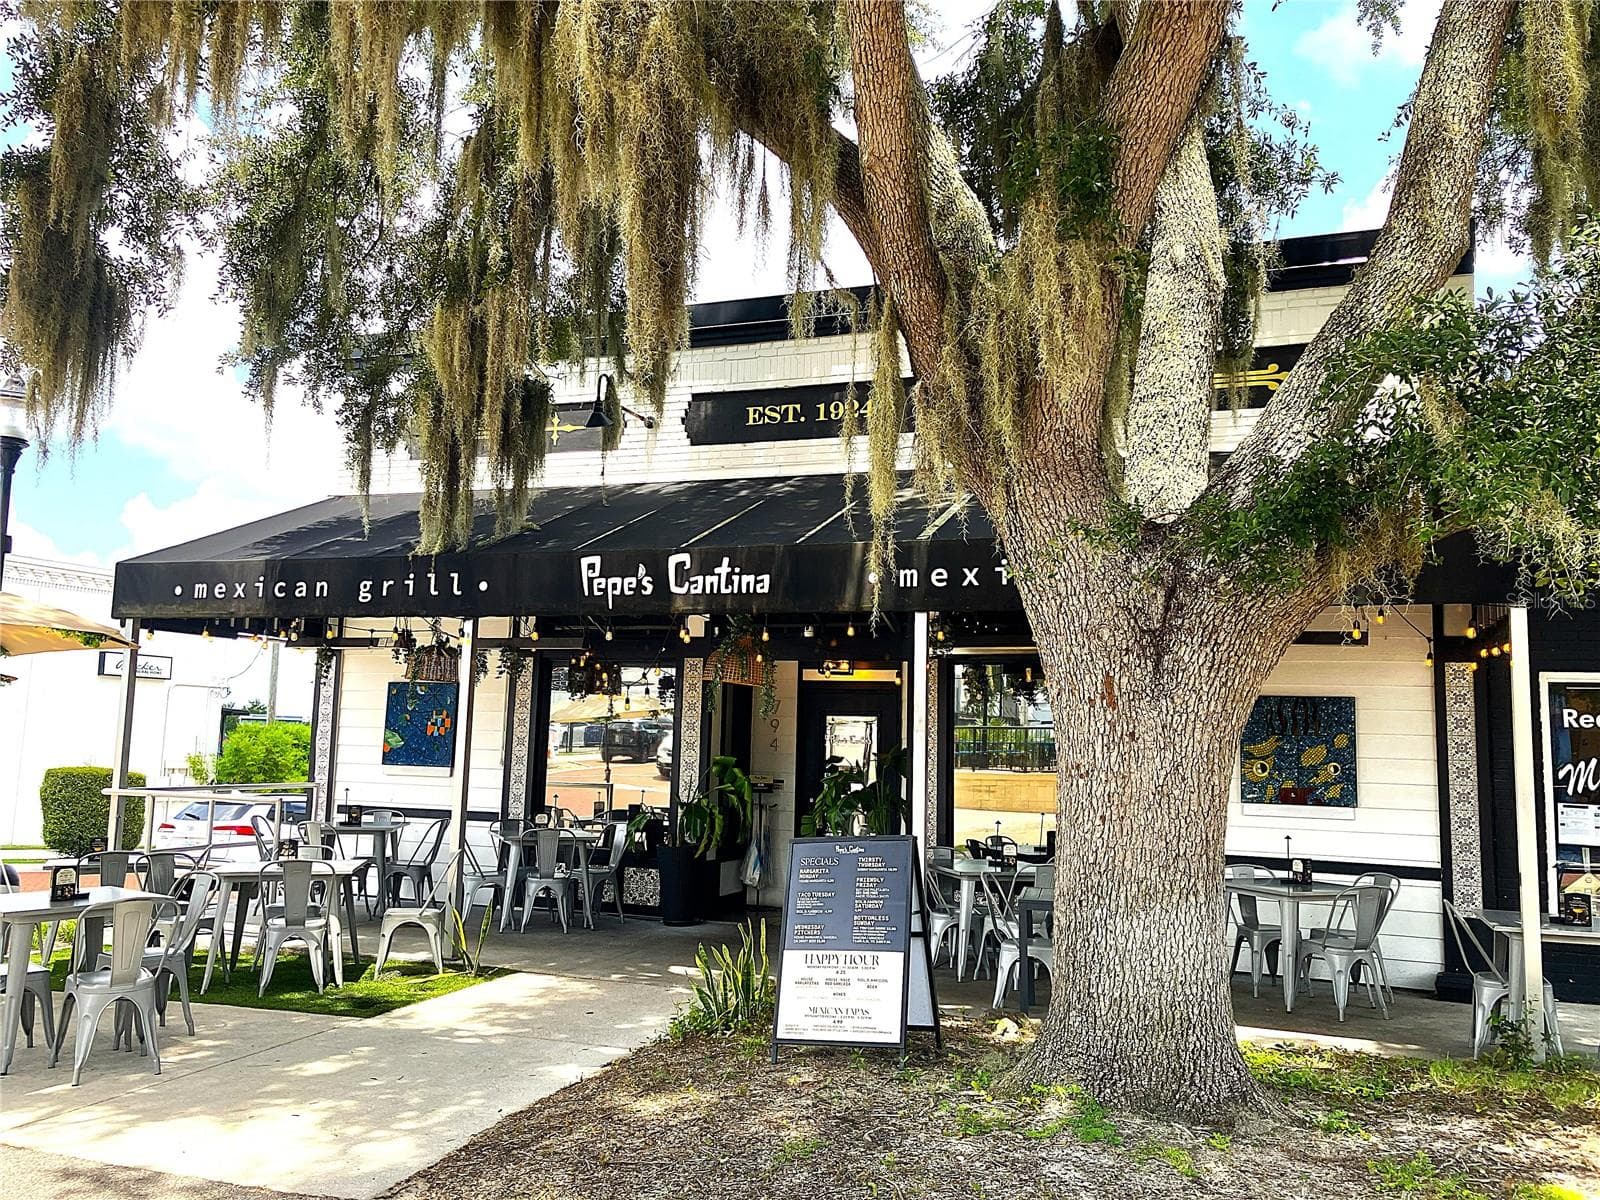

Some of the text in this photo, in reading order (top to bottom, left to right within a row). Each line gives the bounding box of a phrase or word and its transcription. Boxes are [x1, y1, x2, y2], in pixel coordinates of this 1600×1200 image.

[745, 398, 874, 426] EST. 1924
[193, 572, 463, 603] mexican grill
[580, 552, 770, 610] Pepe's Cantina
[800, 857, 839, 866] SPECIALS
[804, 953, 880, 966] HAPPY HOUR
[808, 1006, 843, 1015] MEXICAN
